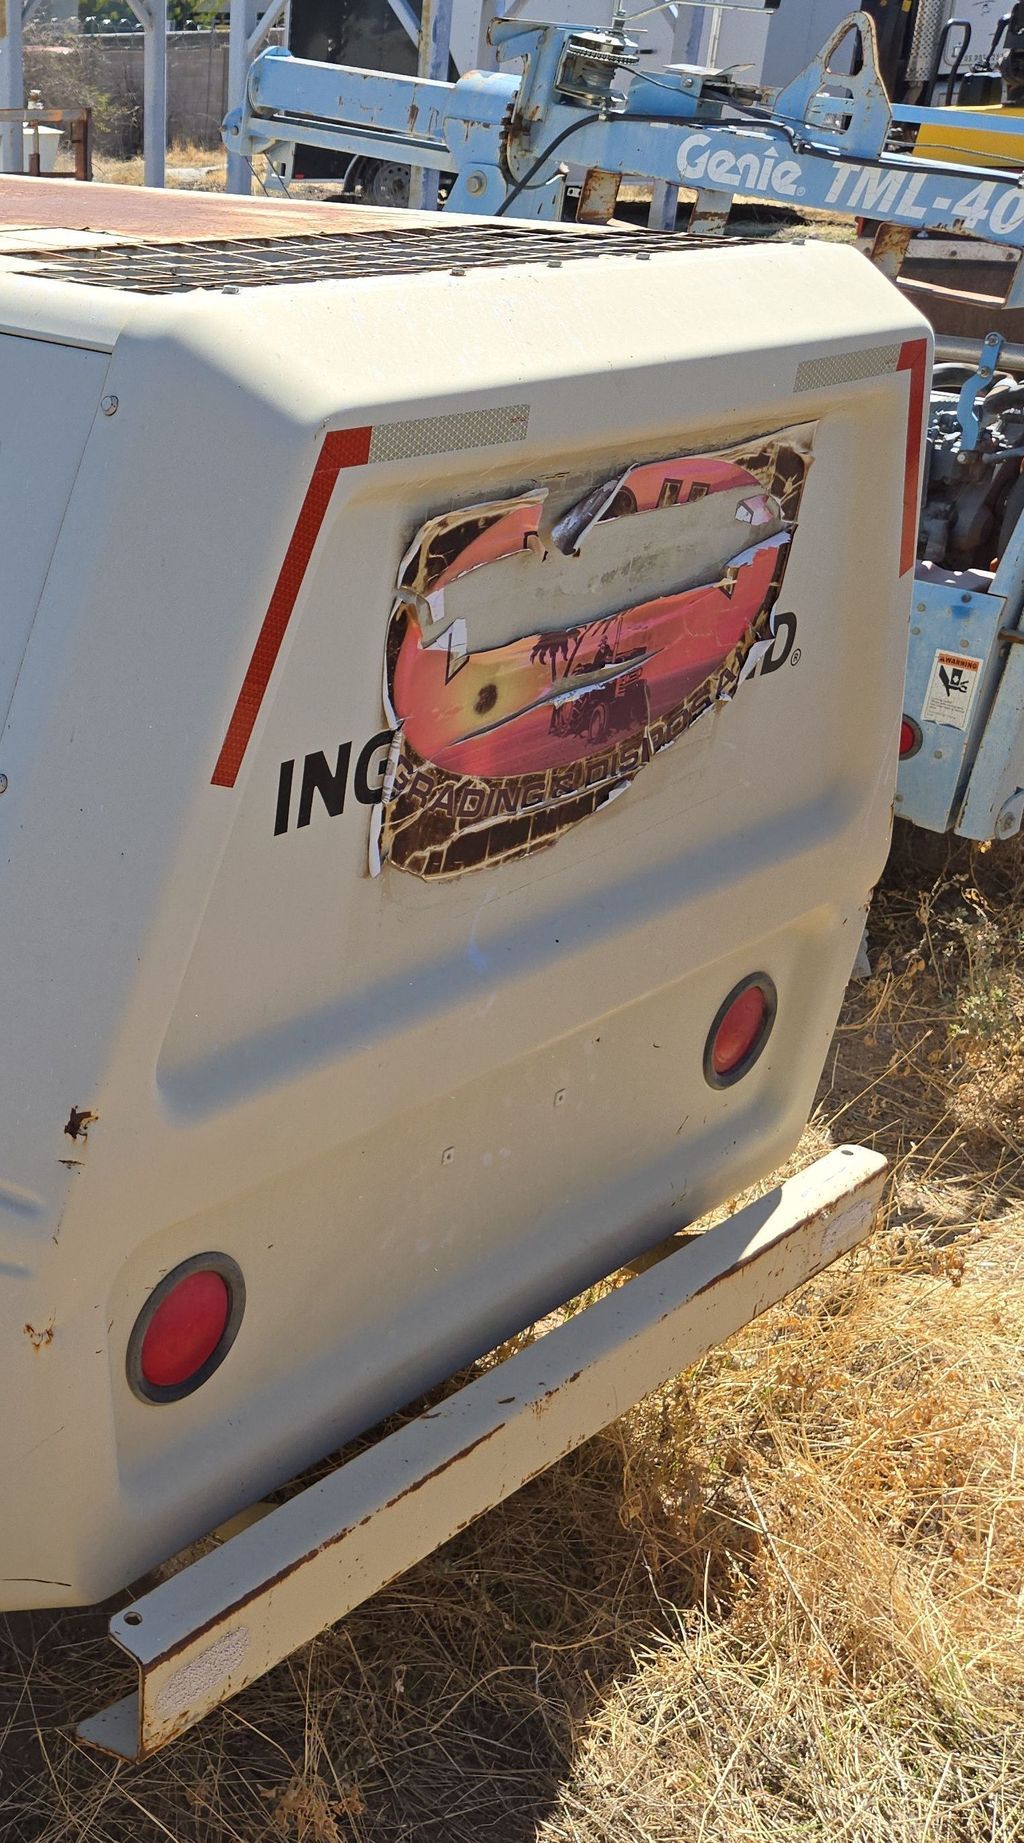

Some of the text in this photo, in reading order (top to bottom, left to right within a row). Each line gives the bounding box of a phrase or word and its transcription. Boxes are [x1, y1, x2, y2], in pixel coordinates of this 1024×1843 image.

[676, 133, 1024, 235] Genie TML-40
[945, 656, 978, 670] WARNING
[393, 754, 543, 819] GRADING
